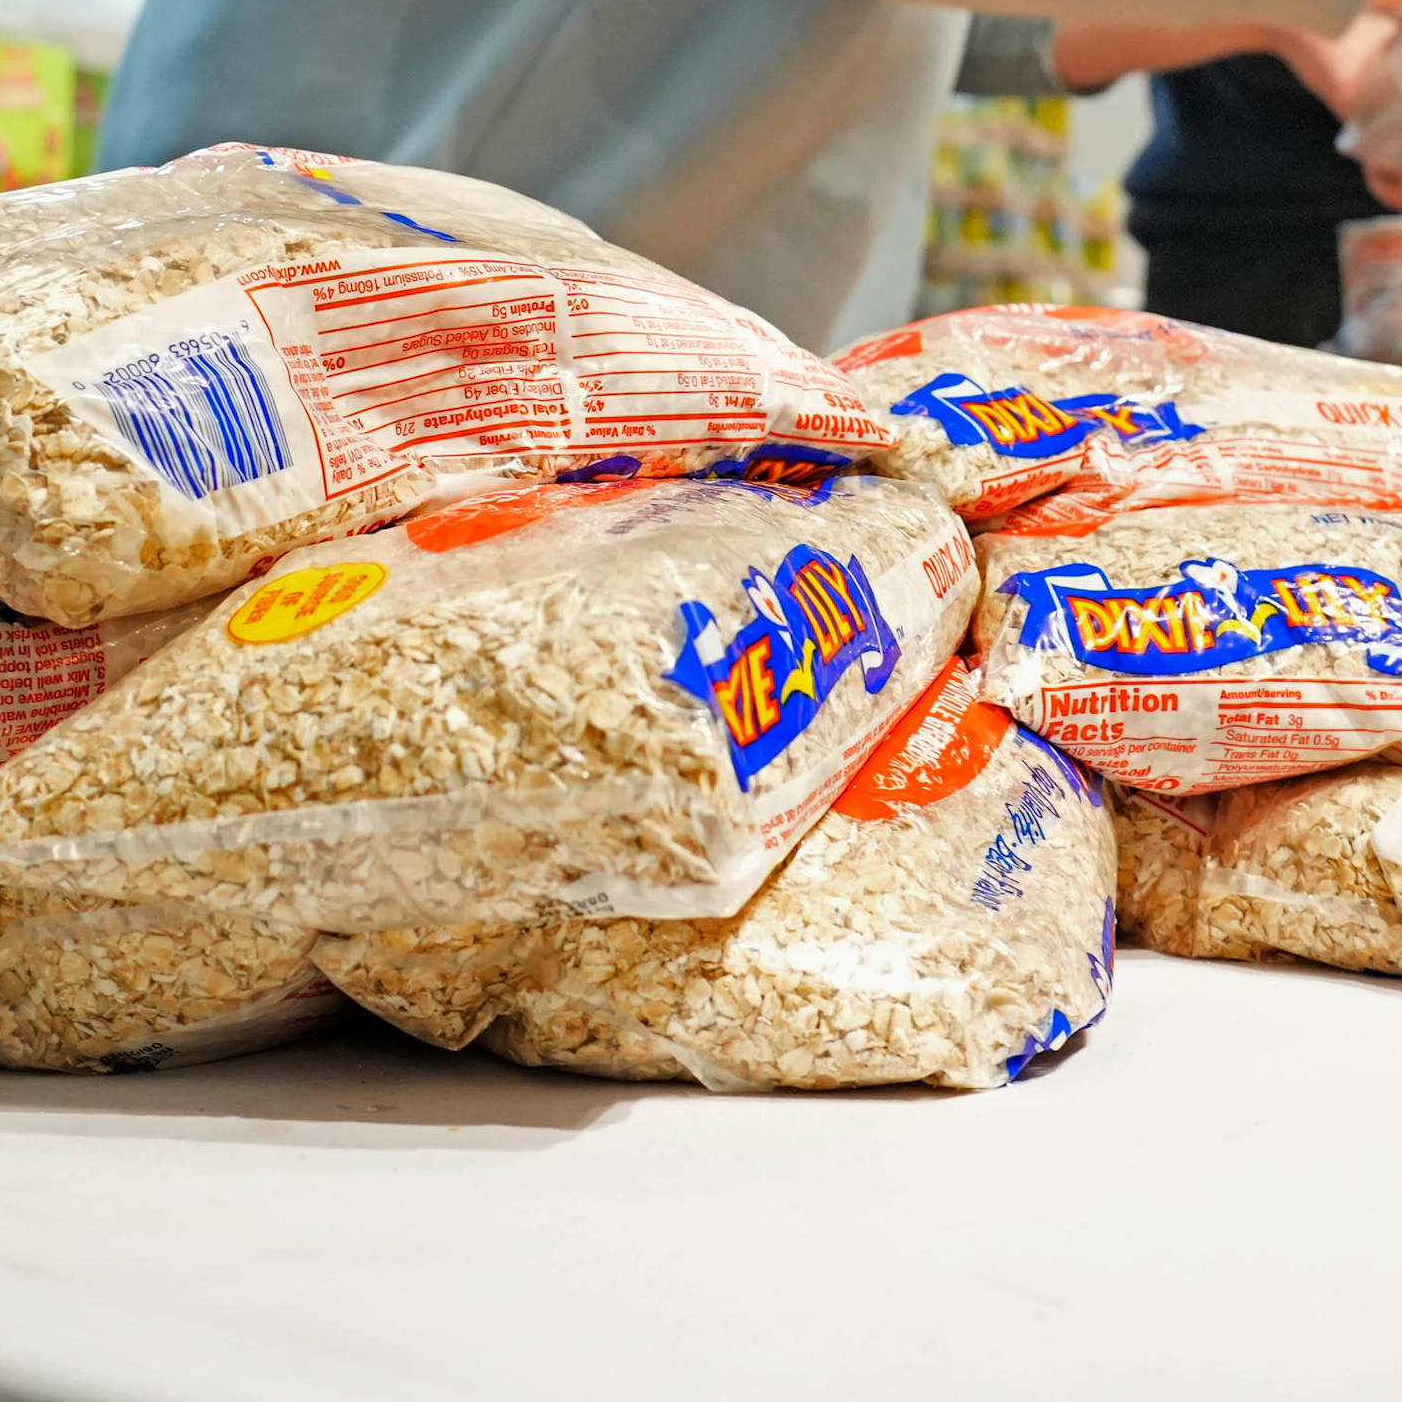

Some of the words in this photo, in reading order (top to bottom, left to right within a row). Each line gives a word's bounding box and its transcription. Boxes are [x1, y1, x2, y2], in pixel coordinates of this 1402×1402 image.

[337, 273, 380, 293] 160mg
[383, 268, 444, 287] Potassium
[313, 285, 335, 300] 4%
[491, 303, 507, 319] 5g
[510, 299, 555, 316] Protein
[567, 298, 589, 311] 0%
[492, 325, 508, 340] 0g
[512, 321, 556, 337] Includes
[402, 334, 443, 353] Sugars
[444, 329, 489, 347] Added
[462, 346, 478, 359] 0g
[482, 343, 530, 358] Sugars
[103, 353, 160, 383] 60002
[323, 356, 345, 371] 0%
[677, 373, 698, 388] 0.5g
[464, 385, 482, 400] 4g
[533, 403, 568, 415] Total
[583, 399, 605, 413] 4%
[423, 404, 529, 429] Carbohydrate
[395, 421, 416, 436] 27g
[621, 425, 645, 436] Daily
[332, 466, 352, 482] Daily
[922, 543, 959, 599] QUICK
[789, 559, 866, 666] LILY
[1066, 590, 1215, 655] DIXIE
[6, 628, 30, 643] risk
[18, 645, 31, 658] in
[35, 650, 106, 672] Suggested
[66, 669, 90, 683] Mix
[94, 666, 106, 678] 3.
[37, 673, 63, 688] well
[94, 681, 106, 693] 2.
[17, 684, 90, 703] Microwave
[1219, 689, 1302, 701] Amount/serving
[1050, 687, 1179, 718] Nutrition
[1218, 713, 1253, 725] Total
[1257, 713, 1279, 725] Fat
[1288, 714, 1303, 728] 3g
[1046, 719, 1124, 743] Facts
[1226, 729, 1287, 745] Saturated
[1290, 733, 1310, 745] Fat
[1312, 732, 1340, 747] 0.5g
[1087, 743, 1127, 757] servings
[1128, 744, 1146, 757] per
[1147, 742, 1197, 754] container
[1223, 748, 1258, 759] Trans
[1260, 749, 1280, 760] Fat
[1282, 750, 1298, 760] 0g
[1005, 781, 1059, 845] Quality
